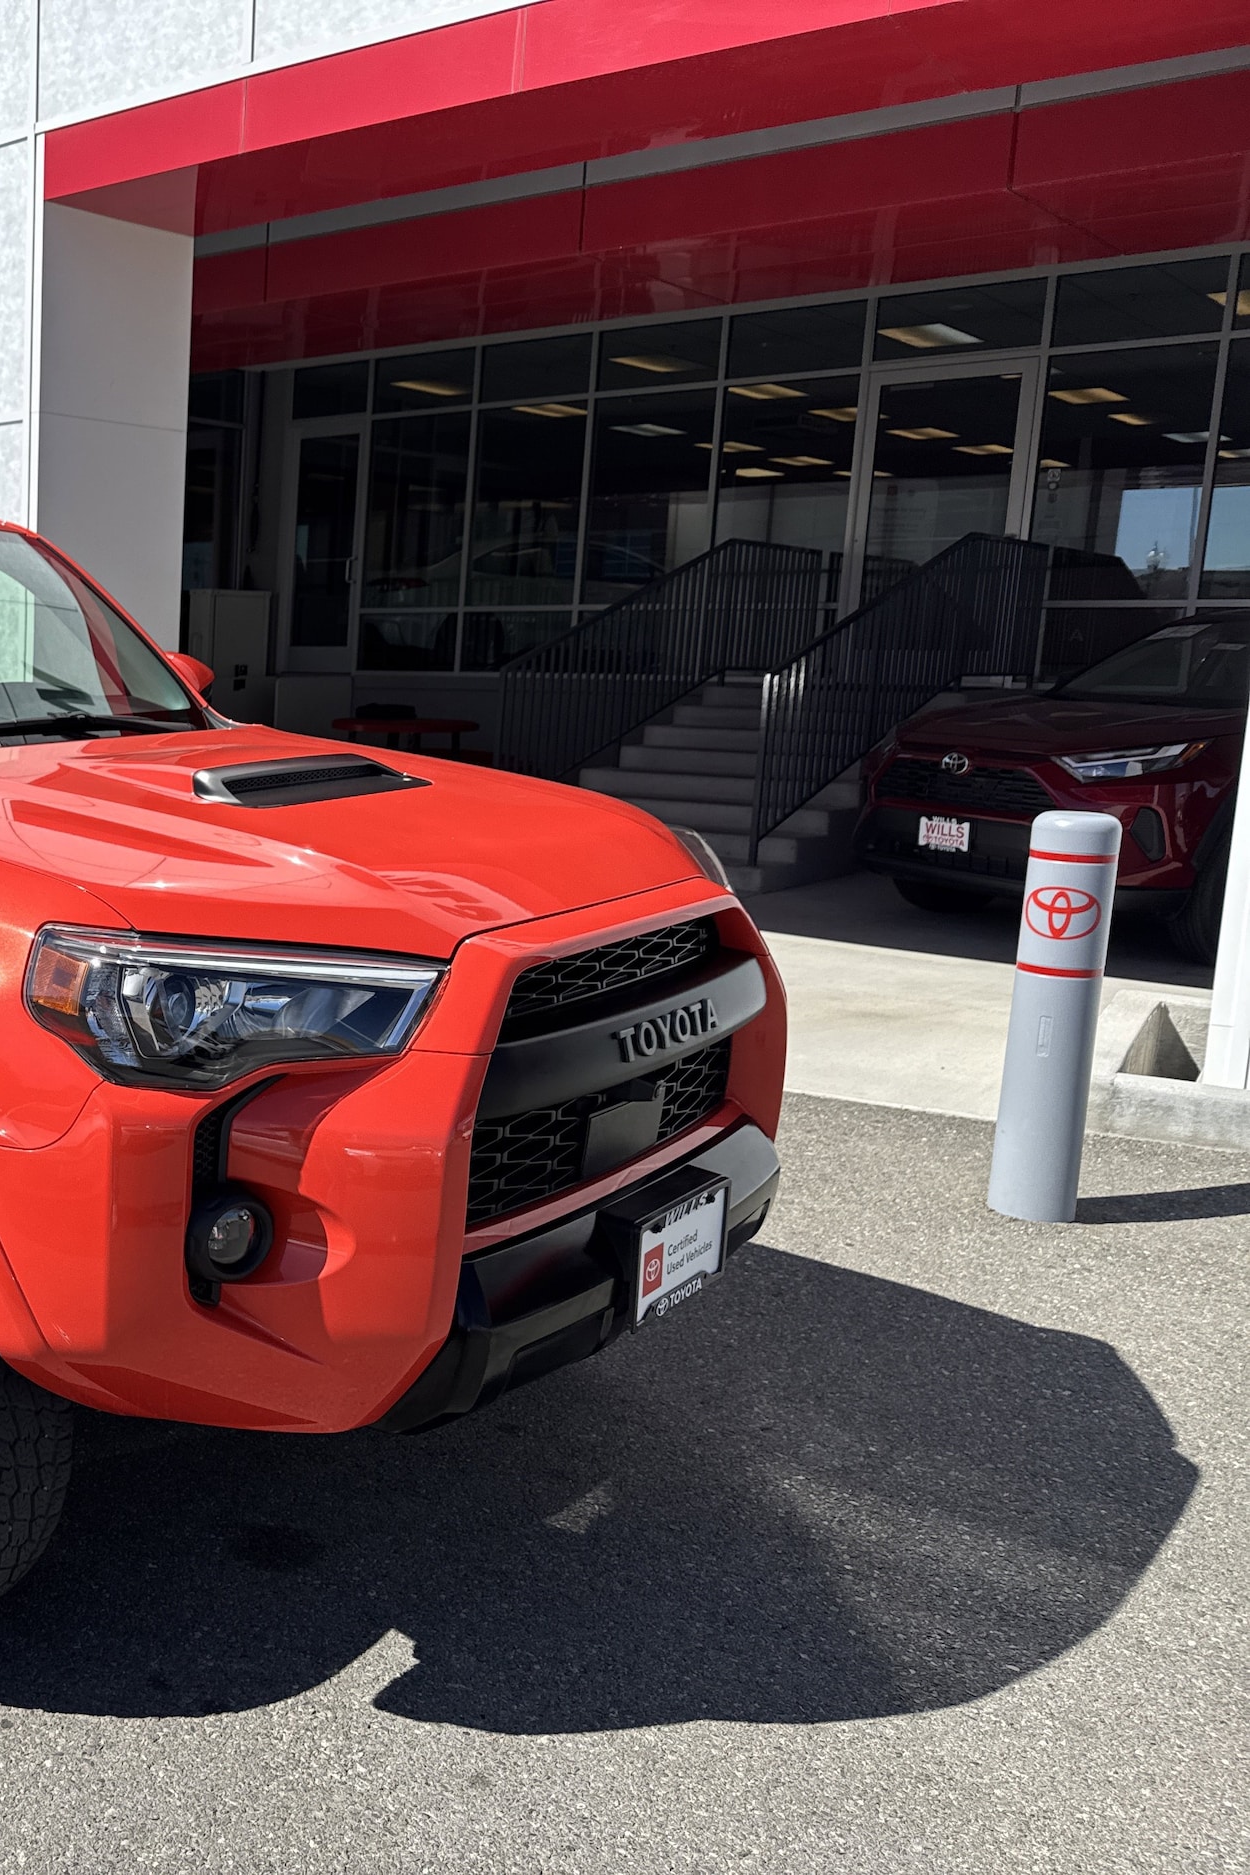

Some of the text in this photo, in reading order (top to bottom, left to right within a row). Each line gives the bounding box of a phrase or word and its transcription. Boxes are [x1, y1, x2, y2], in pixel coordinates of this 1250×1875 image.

[925, 822, 965, 839] WILLS
[934, 836, 965, 847] TOYOTA
[612, 998, 719, 1063] TOYOTA
[666, 1240, 713, 1275] Used Vehicles
[667, 1229, 699, 1257] Certified
[669, 1277, 703, 1308] TOYOTA
